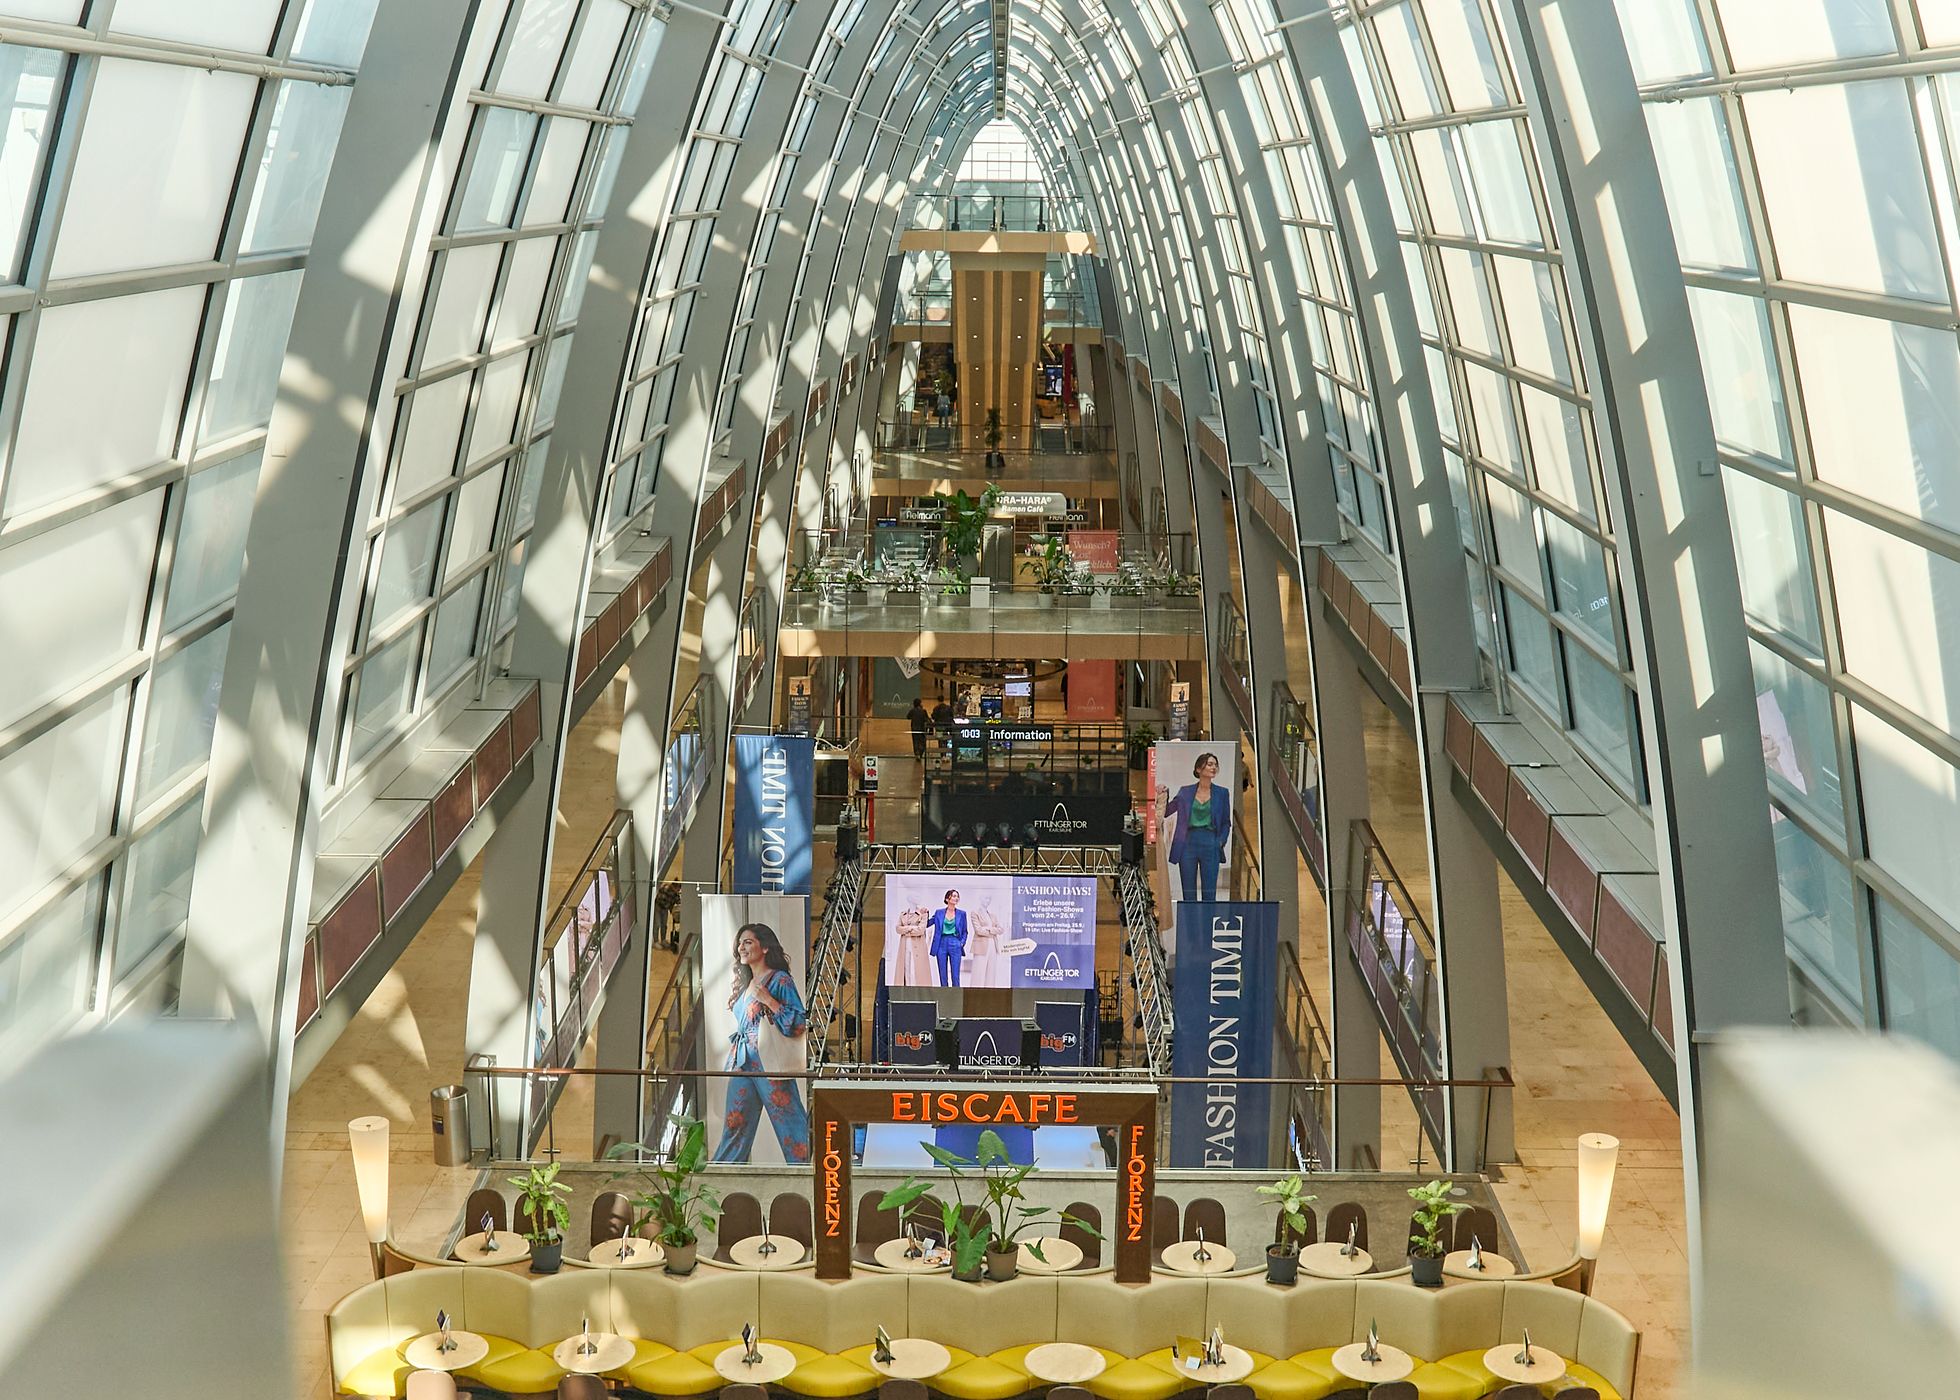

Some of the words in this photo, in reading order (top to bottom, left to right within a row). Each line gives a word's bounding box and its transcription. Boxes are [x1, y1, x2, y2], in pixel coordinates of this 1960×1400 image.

[1002, 505, 1025, 513] Ramen
[1027, 505, 1044, 513] Café
[1073, 540, 1111, 550] Wunsch?
[960, 729, 981, 739] 10:03
[989, 729, 1052, 741] Information
[1072, 820, 1087, 828] TOR
[1017, 886, 1061, 896] FASHION
[1063, 886, 1091, 896] DAYS!
[1209, 914, 1243, 1005] TIME
[1025, 969, 1064, 977] ETTLINGER
[1065, 969, 1080, 977] TOR
[1204, 1015, 1240, 1168] FASHION
[891, 1092, 1079, 1123] EISCAFE
[823, 1121, 841, 1237] FLORENZ
[1127, 1125, 1145, 1242] FLORENZ
